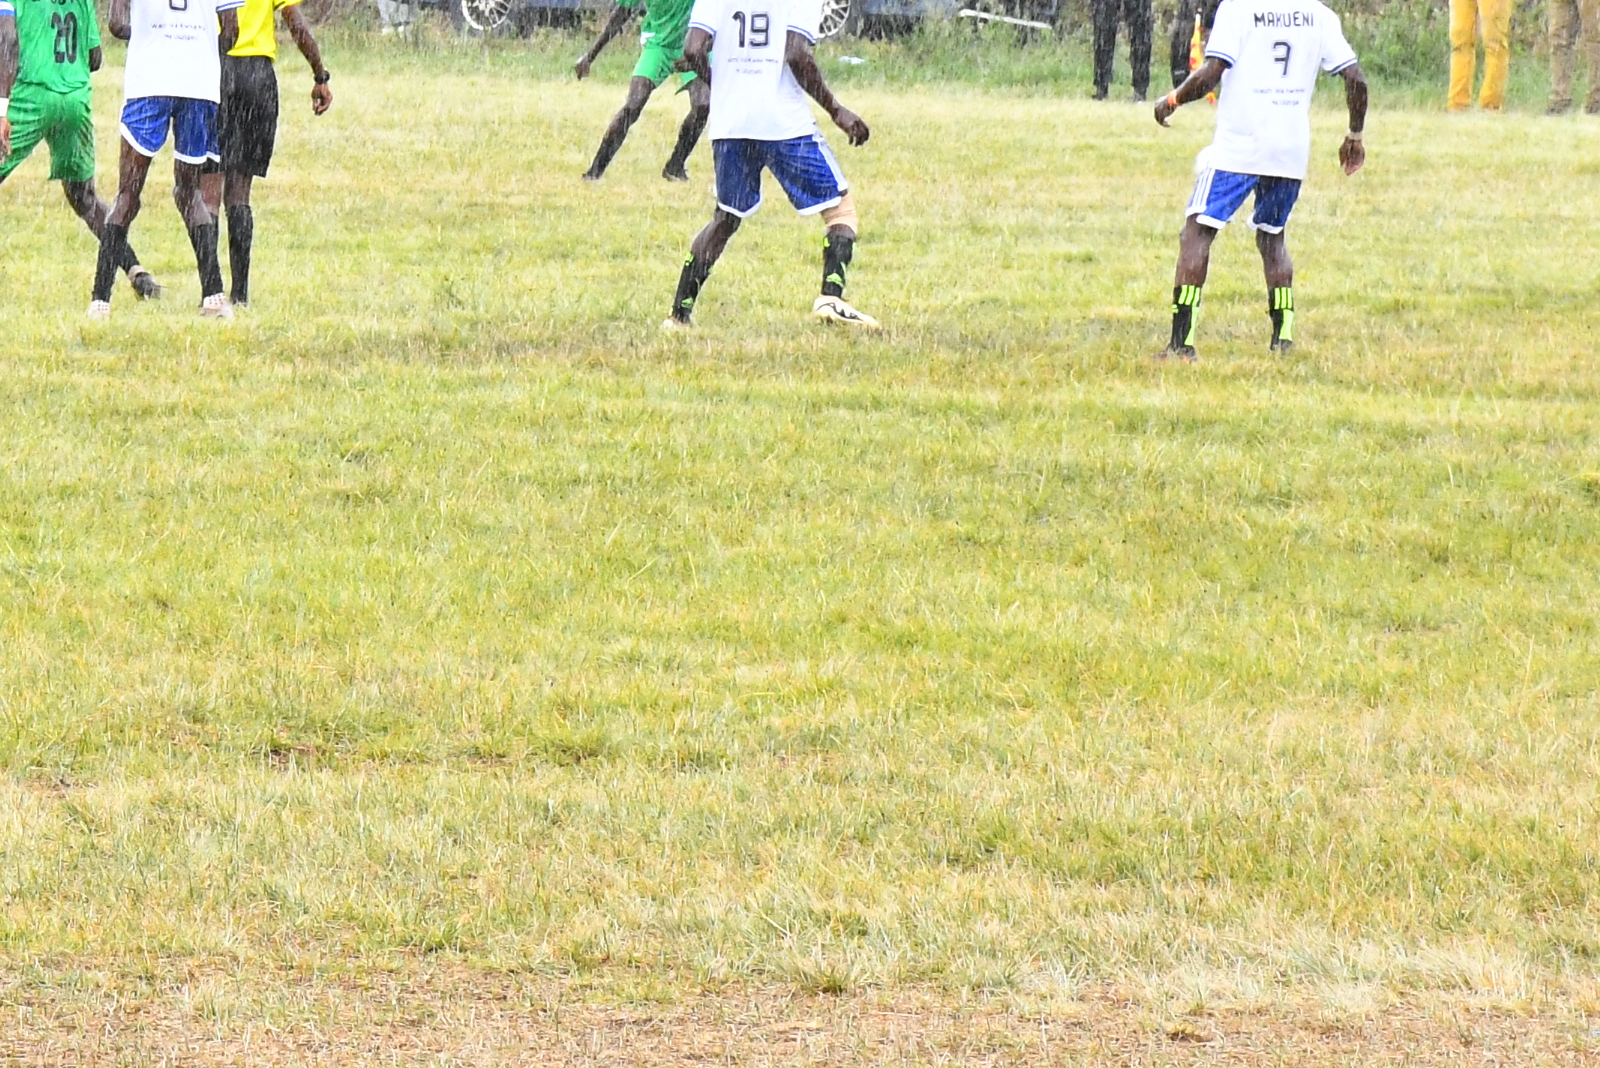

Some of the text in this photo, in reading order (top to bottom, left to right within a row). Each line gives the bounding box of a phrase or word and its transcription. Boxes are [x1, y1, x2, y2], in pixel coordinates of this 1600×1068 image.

[51, 11, 77, 64] 20
[732, 11, 770, 49] 19
[1253, 11, 1314, 28] MAKUENI
[1272, 41, 1292, 76] 7
